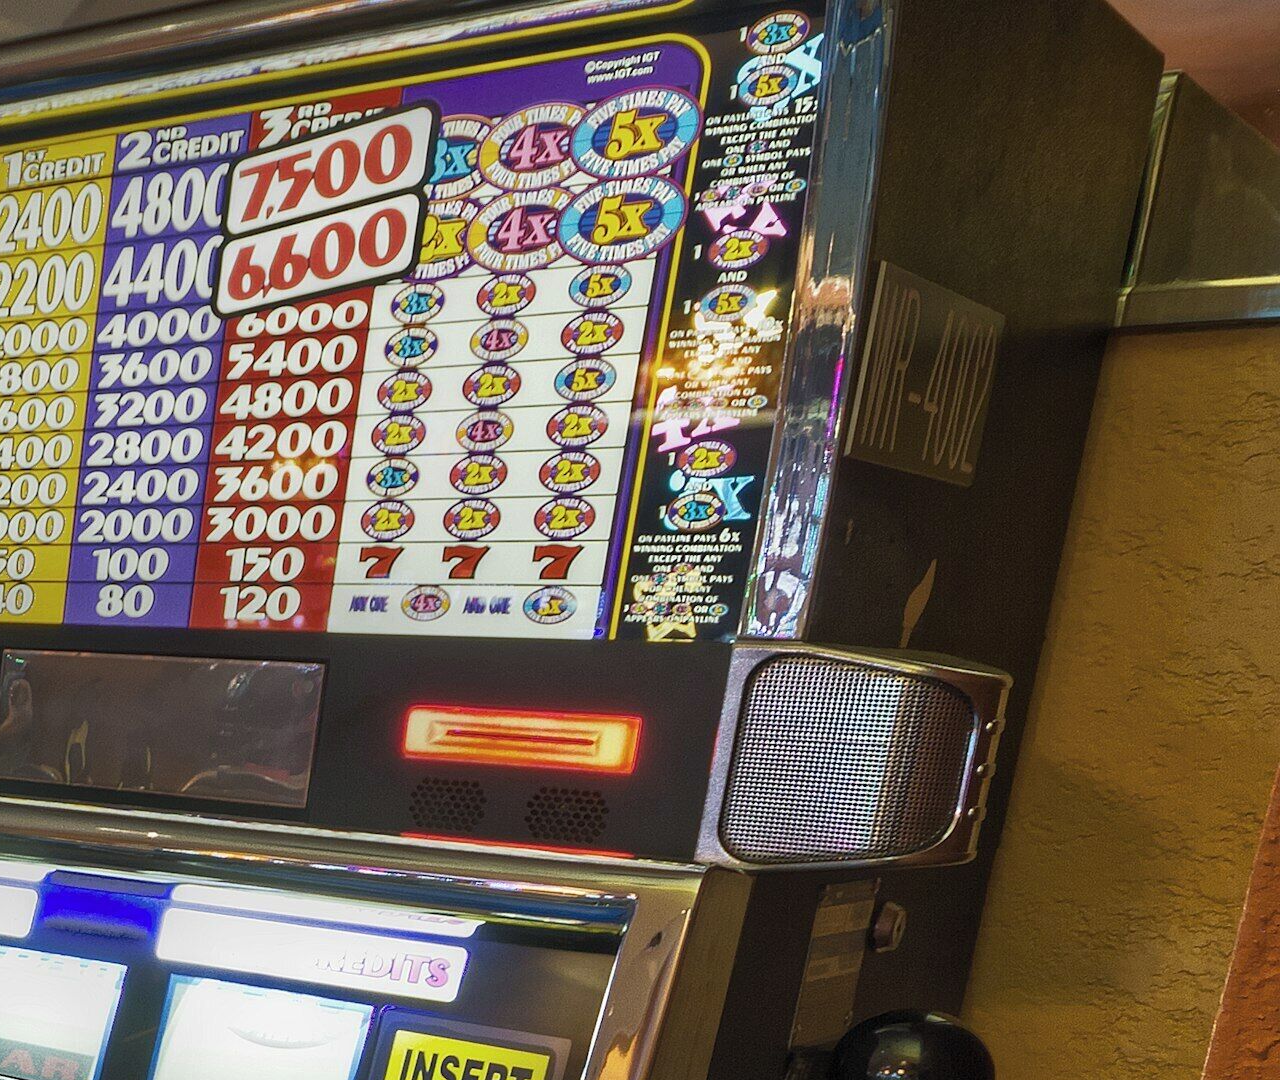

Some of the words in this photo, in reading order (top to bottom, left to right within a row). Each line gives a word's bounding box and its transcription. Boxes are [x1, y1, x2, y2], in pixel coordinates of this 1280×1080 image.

[586, 65, 654, 85] www.IGT.com
[640, 50, 661, 64] IGT
[587, 99, 619, 128] FIVE
[618, 89, 667, 112] TIMES
[667, 95, 692, 119] PAY
[152, 129, 245, 164] CREDIT
[21, 152, 107, 183] CREDIT
[239, 124, 413, 223] 7,500
[227, 207, 408, 300] 6,600
[717, 270, 748, 283] AND
[96, 307, 222, 349] 4000
[235, 299, 369, 338] 6000
[97, 346, 213, 389] 3600
[225, 334, 359, 380] 5400
[93, 387, 208, 428] 3200
[219, 377, 355, 420] 4800
[86, 427, 205, 467] 2800
[214, 420, 348, 461] 4200
[82, 467, 200, 505] 2400
[213, 462, 339, 502] 3600
[77, 507, 195, 543] 2000
[205, 504, 336, 542] 3000
[654, 534, 691, 543] PAYLINE
[692, 533, 717, 543] PAYS
[92, 546, 170, 582] 100
[225, 545, 306, 583] 150
[633, 544, 674, 553] WINNING
[675, 543, 743, 553] COMBINATION
[94, 583, 156, 619] 80
[219, 585, 302, 622] 120
